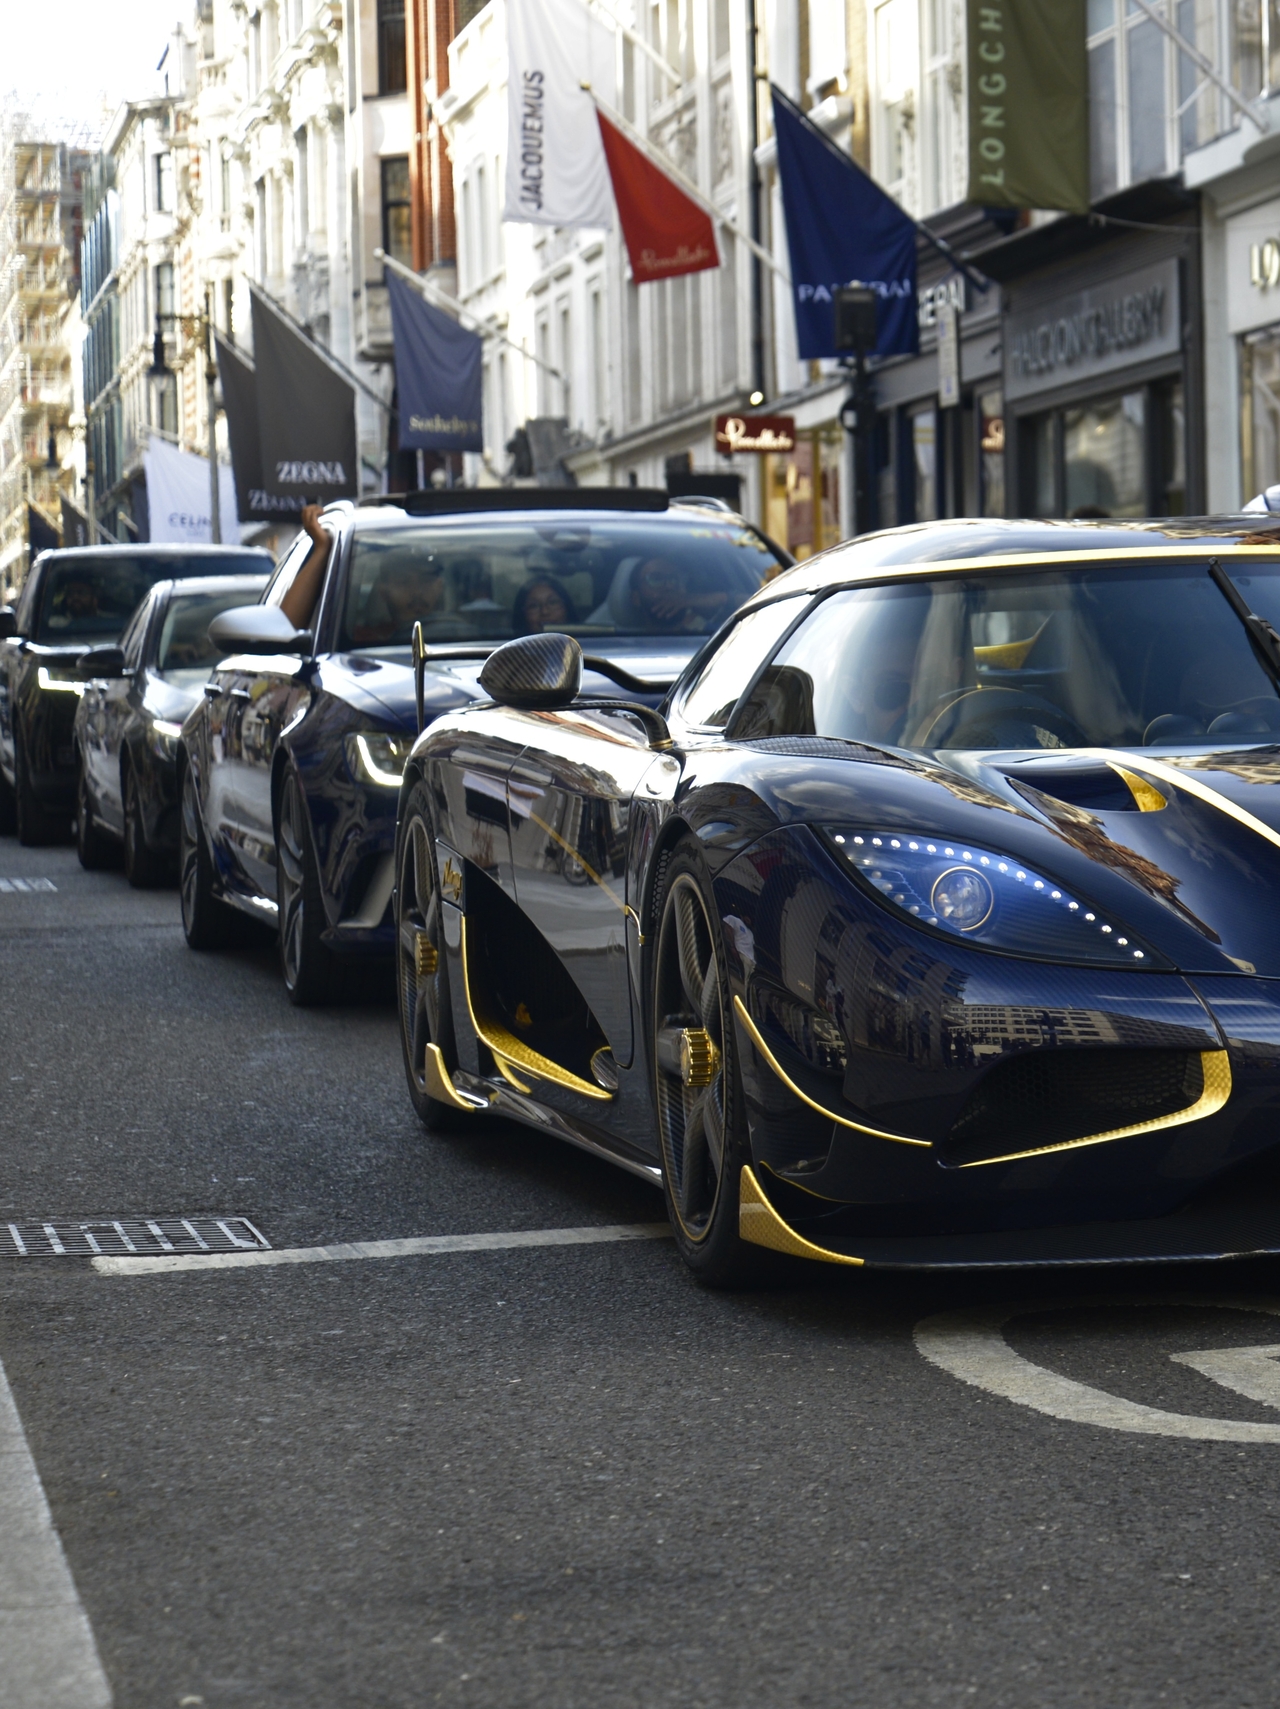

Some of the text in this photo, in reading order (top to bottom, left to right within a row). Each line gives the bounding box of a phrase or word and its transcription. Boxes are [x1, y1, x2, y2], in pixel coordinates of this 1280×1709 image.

[519, 69, 545, 210] JACQUEMUS
[798, 278, 911, 302] PARAI
[276, 459, 347, 485] ZEGNA
[168, 511, 213, 528] CELIN
